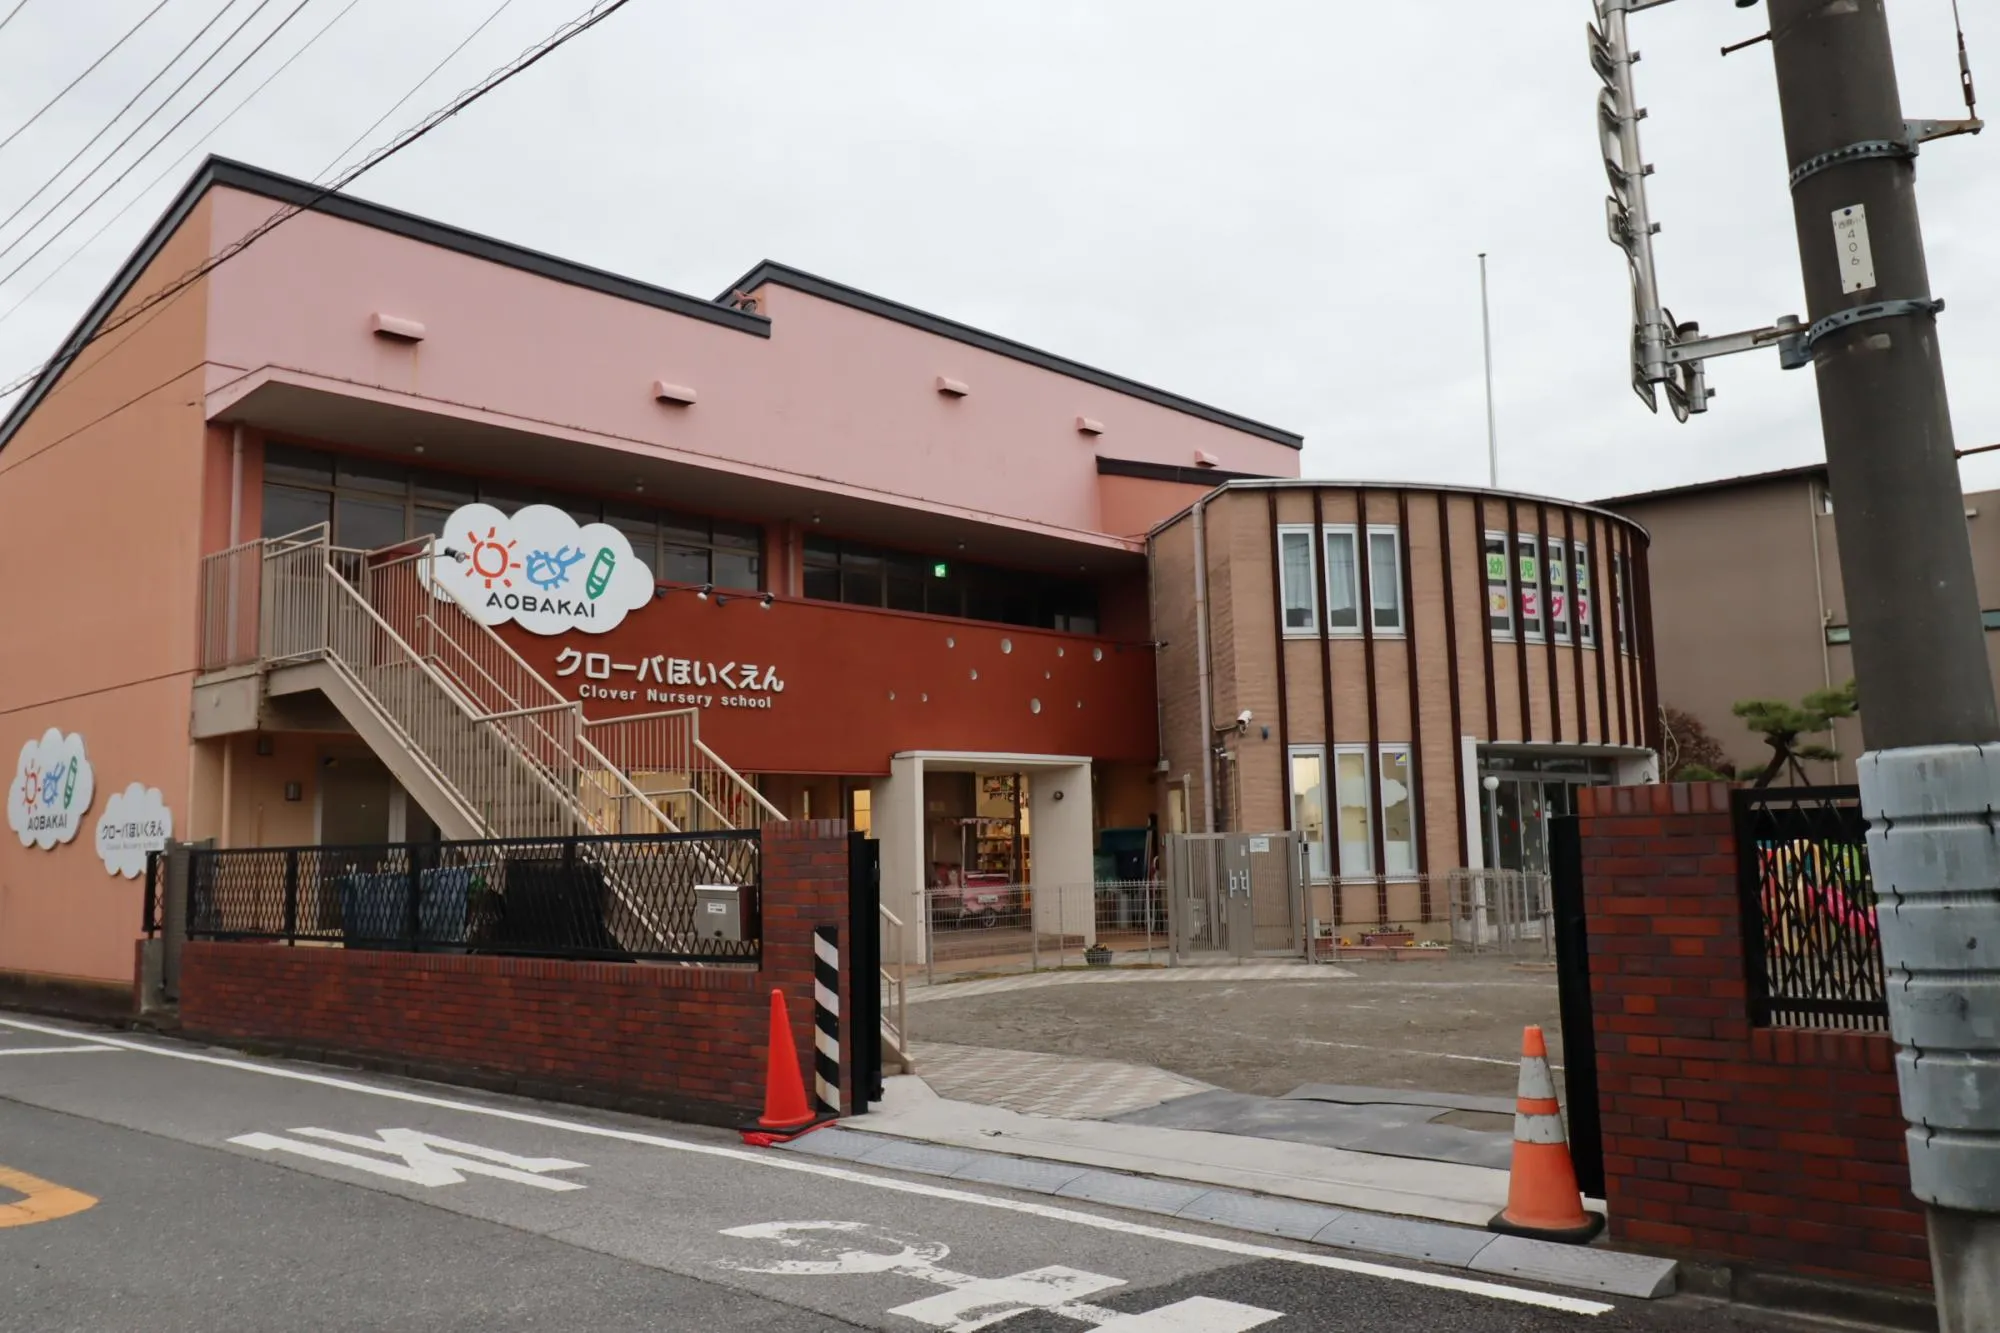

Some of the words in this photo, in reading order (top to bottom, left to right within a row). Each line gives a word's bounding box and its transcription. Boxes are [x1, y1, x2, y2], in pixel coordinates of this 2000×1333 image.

[1847, 229, 1860, 266] 406
[485, 592, 596, 619] AOBAKAI
[554, 646, 785, 692] クローバほいくえん
[578, 684, 637, 701] Clover
[646, 688, 713, 708] Nursery
[720, 694, 772, 709] school
[27, 813, 68, 831] AOBAKAI
